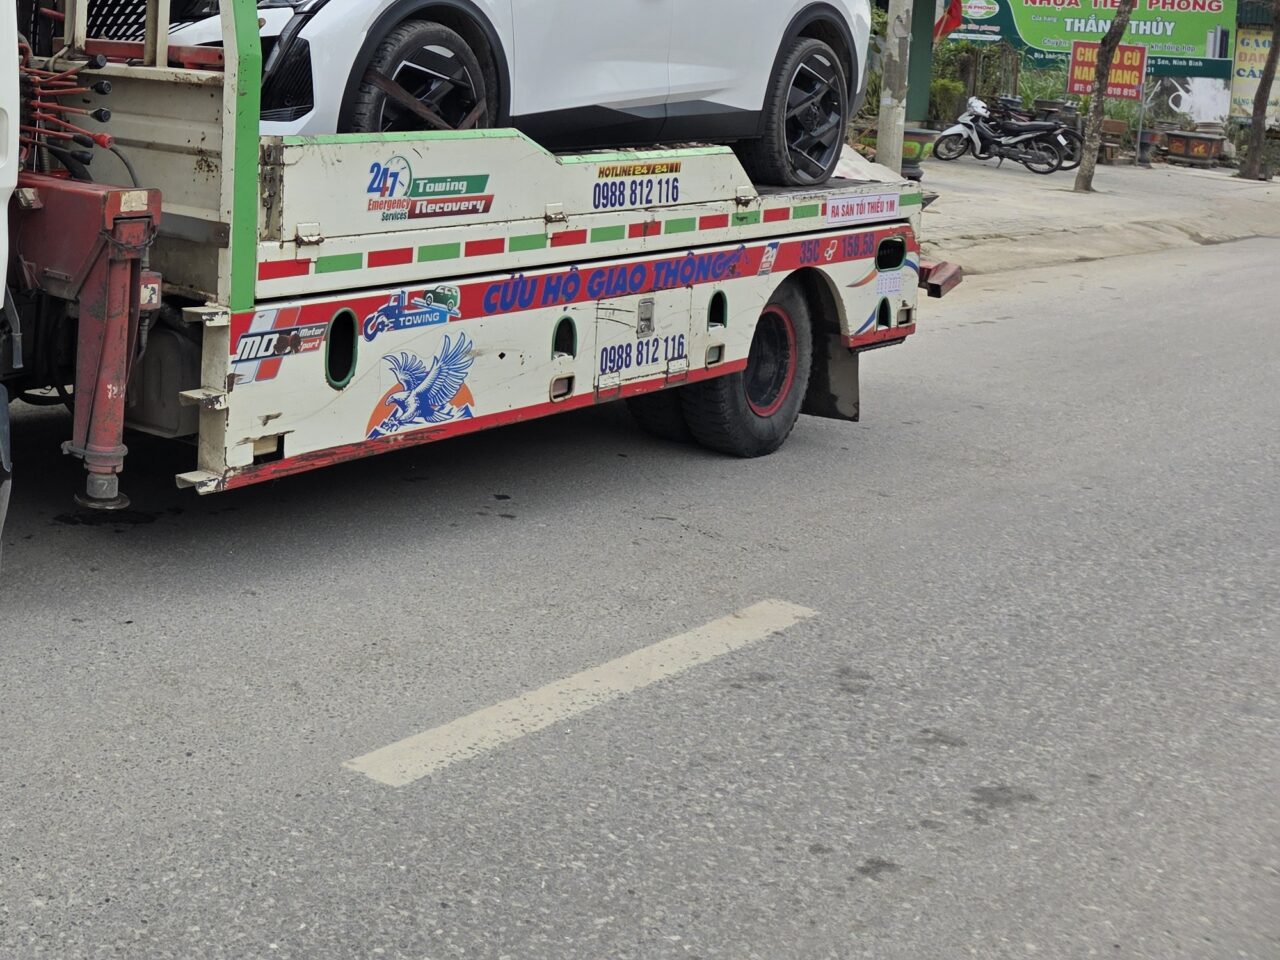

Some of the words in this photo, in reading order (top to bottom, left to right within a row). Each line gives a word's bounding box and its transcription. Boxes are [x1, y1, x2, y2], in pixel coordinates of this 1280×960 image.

[1064, 14, 1111, 33] THẮN
[1128, 17, 1175, 35] THỦY
[598, 165, 633, 178] HOTLINE
[417, 179, 468, 194] Towing
[593, 181, 626, 209] 0988
[629, 178, 653, 206] 812
[657, 176, 680, 203] 116
[367, 198, 411, 212] Emergency
[415, 199, 486, 215] Recovery
[831, 204, 840, 218] RA
[381, 211, 408, 221] Services
[800, 239, 821, 264] 35C
[841, 232, 876, 258] 158.58
[483, 271, 538, 314] CỨU
[541, 264, 582, 311] HỘ
[586, 263, 647, 298] GIAO
[653, 250, 730, 288] THÔNG
[399, 312, 440, 327] TOWING
[300, 327, 324, 337] Motor
[300, 339, 320, 352] port
[600, 341, 633, 375] 0988
[635, 337, 659, 367] 812
[663, 333, 685, 360] 116
